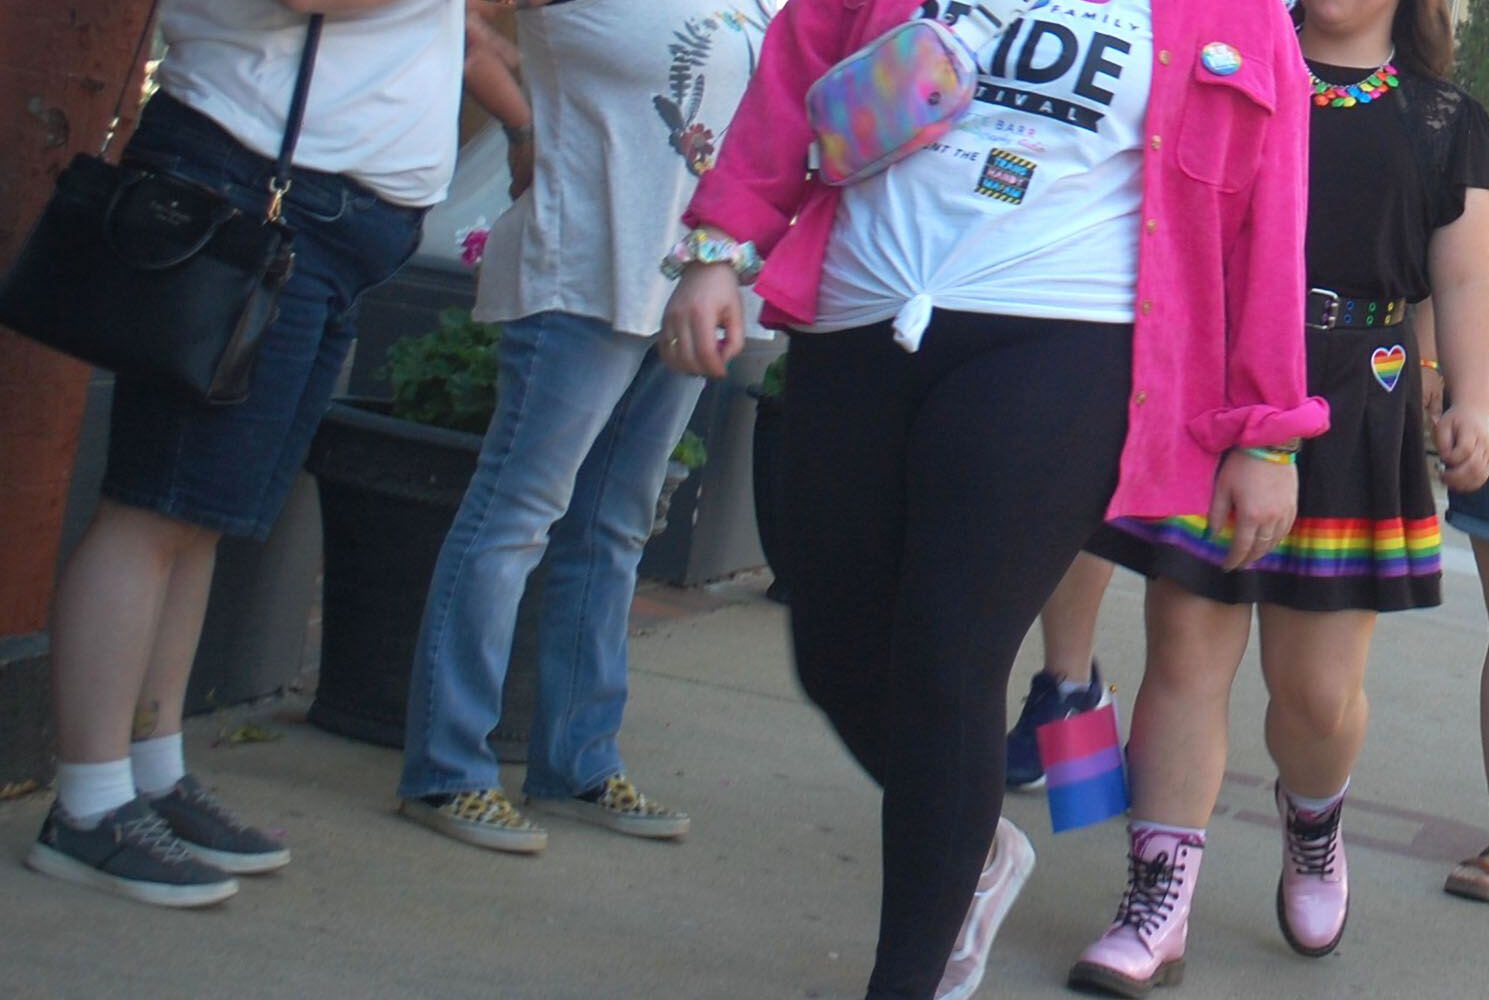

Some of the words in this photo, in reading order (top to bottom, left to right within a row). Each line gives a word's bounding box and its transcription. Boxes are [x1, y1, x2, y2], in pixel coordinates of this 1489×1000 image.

[1050, 4, 1141, 31] FAMILY
[975, 85, 1078, 121] TIVAL
[955, 148, 981, 161] THE
